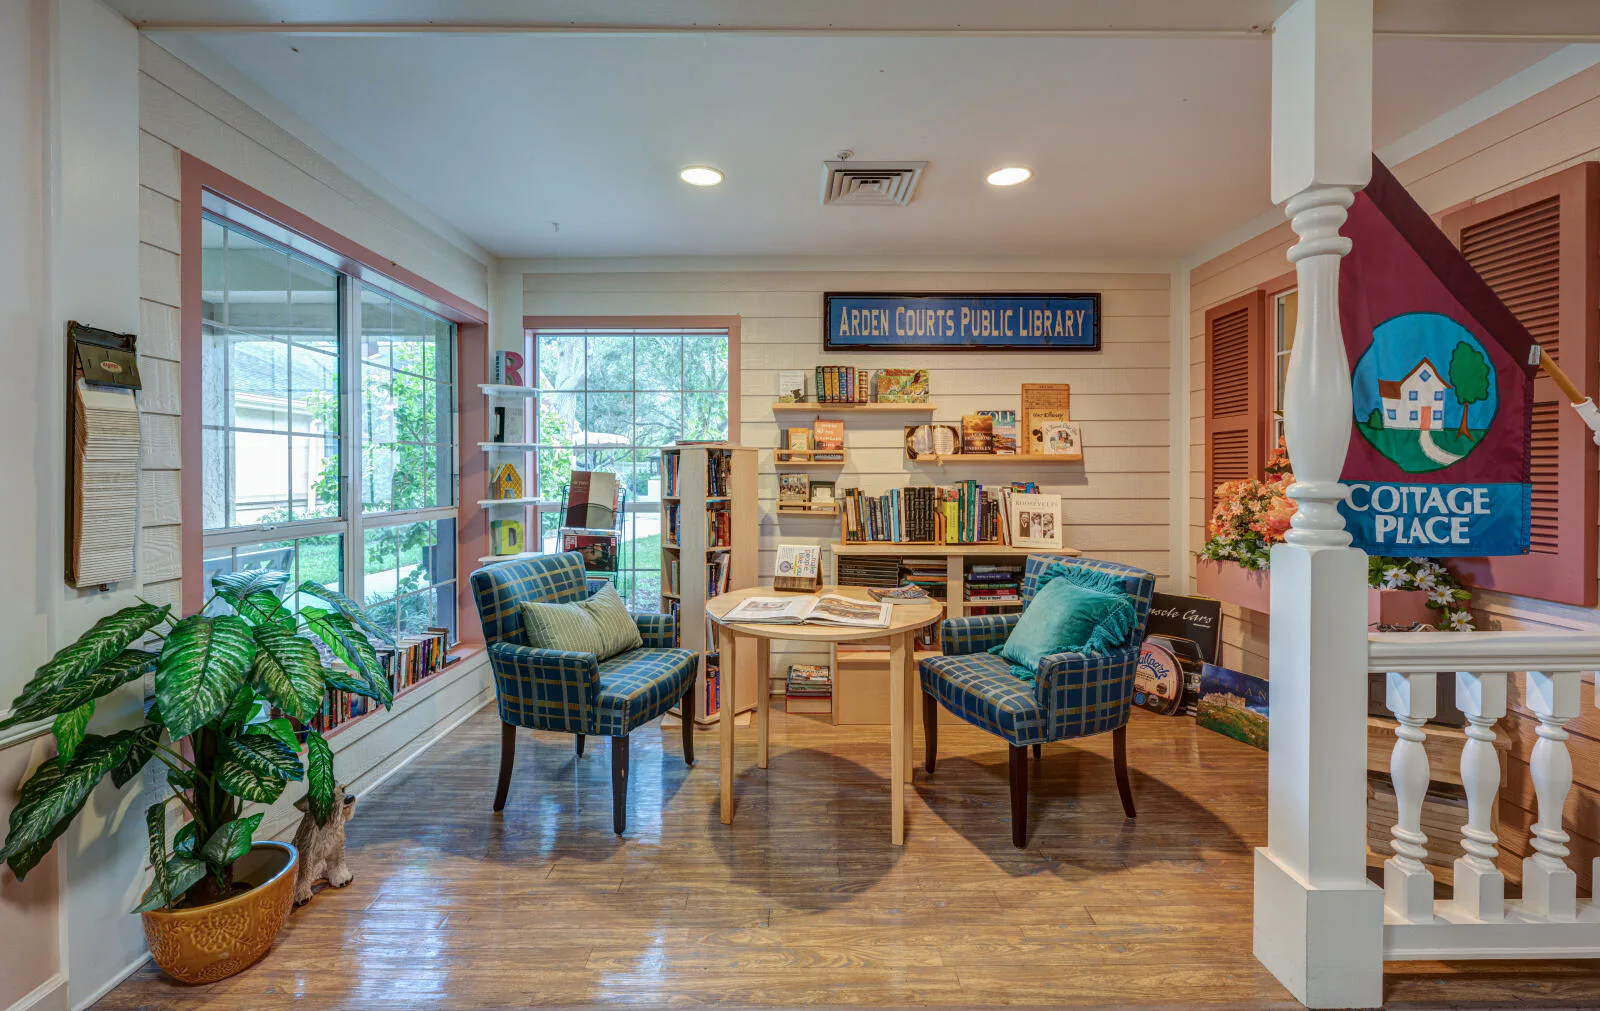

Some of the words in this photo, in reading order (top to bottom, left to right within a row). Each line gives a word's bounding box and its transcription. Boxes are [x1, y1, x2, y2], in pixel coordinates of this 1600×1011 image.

[839, 306, 889, 337] ARDEN
[896, 306, 954, 337] COURTS
[960, 306, 1013, 337] PUBLIC
[1019, 306, 1086, 337] LIBRARY
[1345, 484, 1491, 514] COTTAGE
[1375, 514, 1470, 544] PLACE
[1149, 607, 1180, 618] uscle
[1183, 609, 1213, 624] Cars
[1138, 652, 1169, 679] allpark
